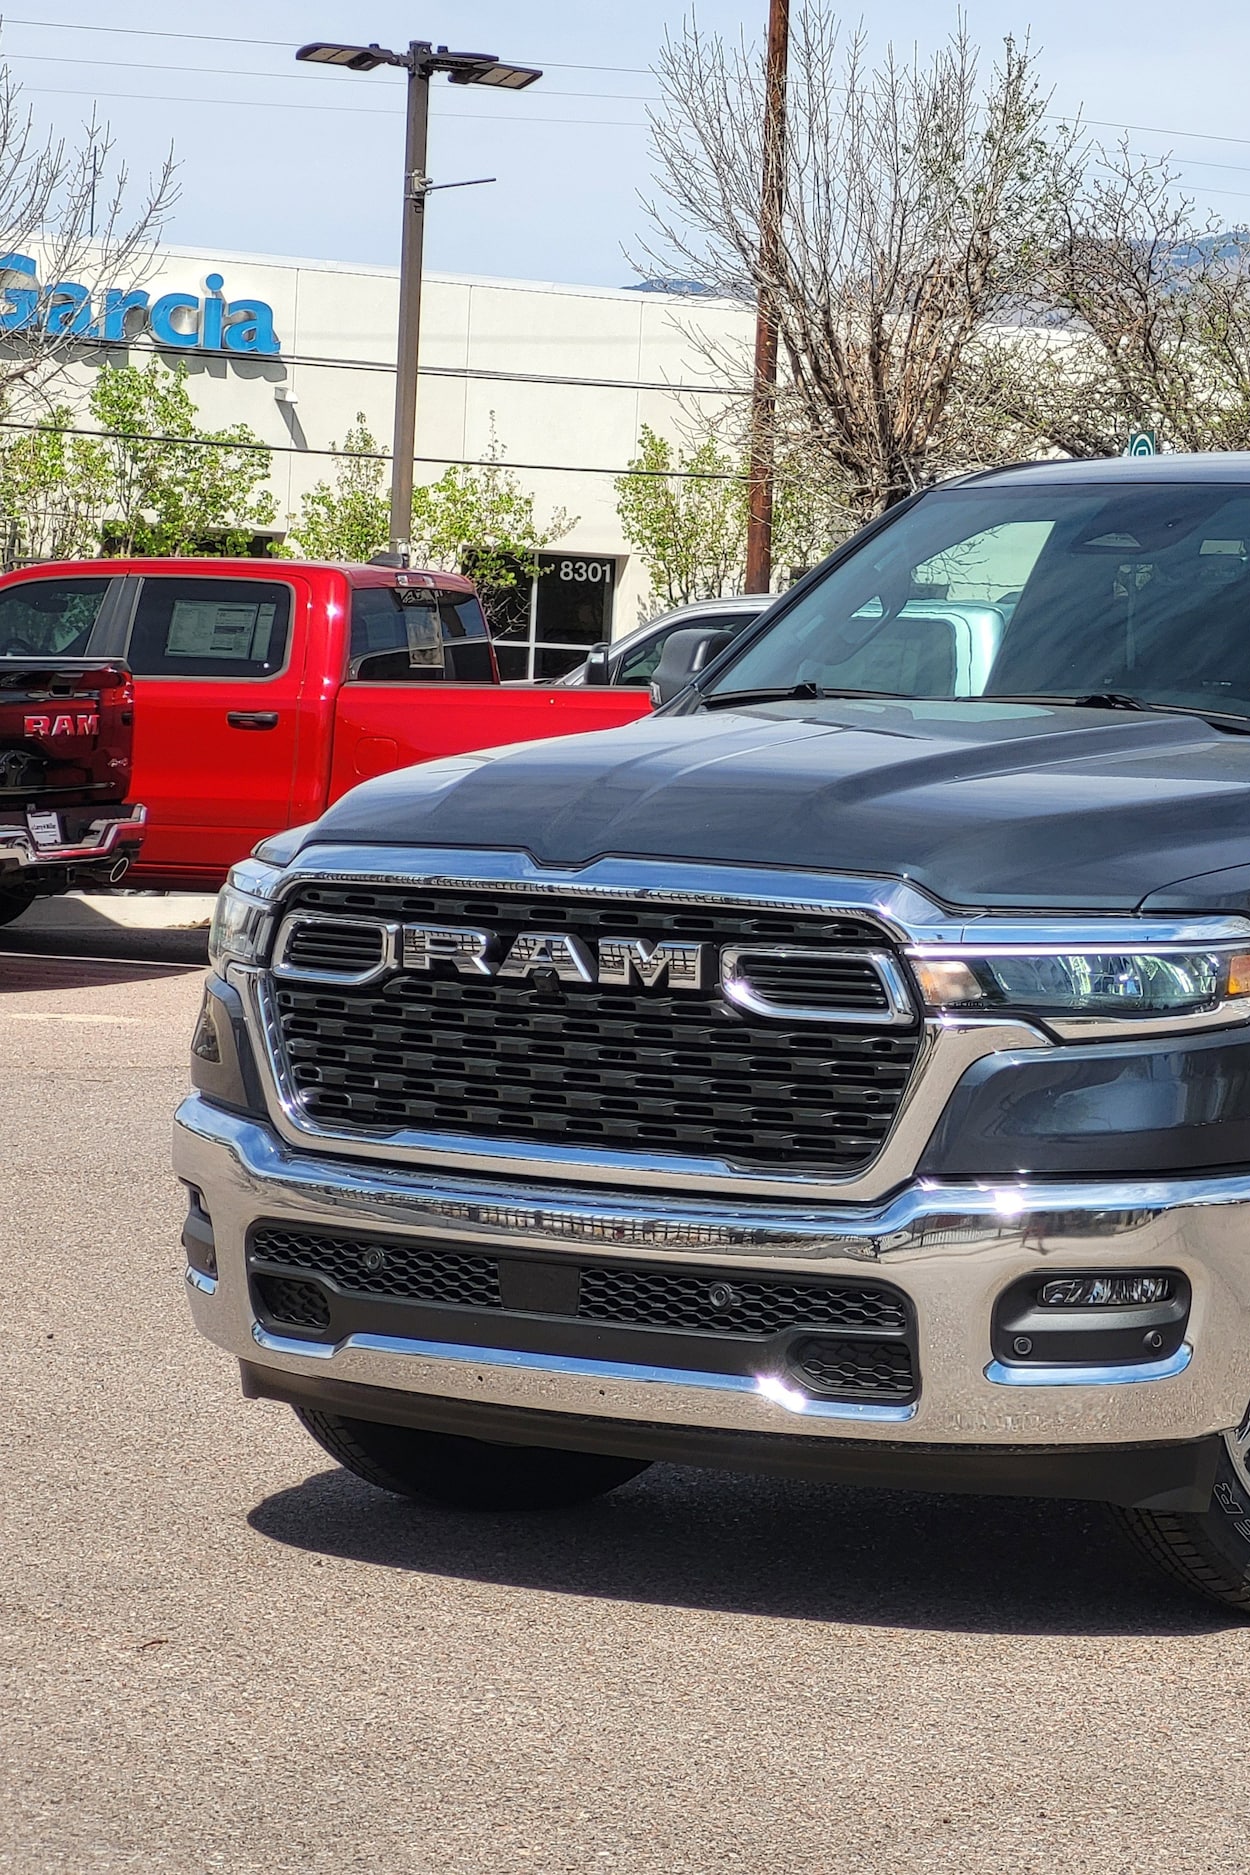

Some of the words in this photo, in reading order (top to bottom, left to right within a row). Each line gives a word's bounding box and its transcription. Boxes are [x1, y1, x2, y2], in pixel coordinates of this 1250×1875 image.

[560, 561, 611, 583] 8301
[24, 714, 99, 737] RAM
[402, 924, 705, 989] RAM
